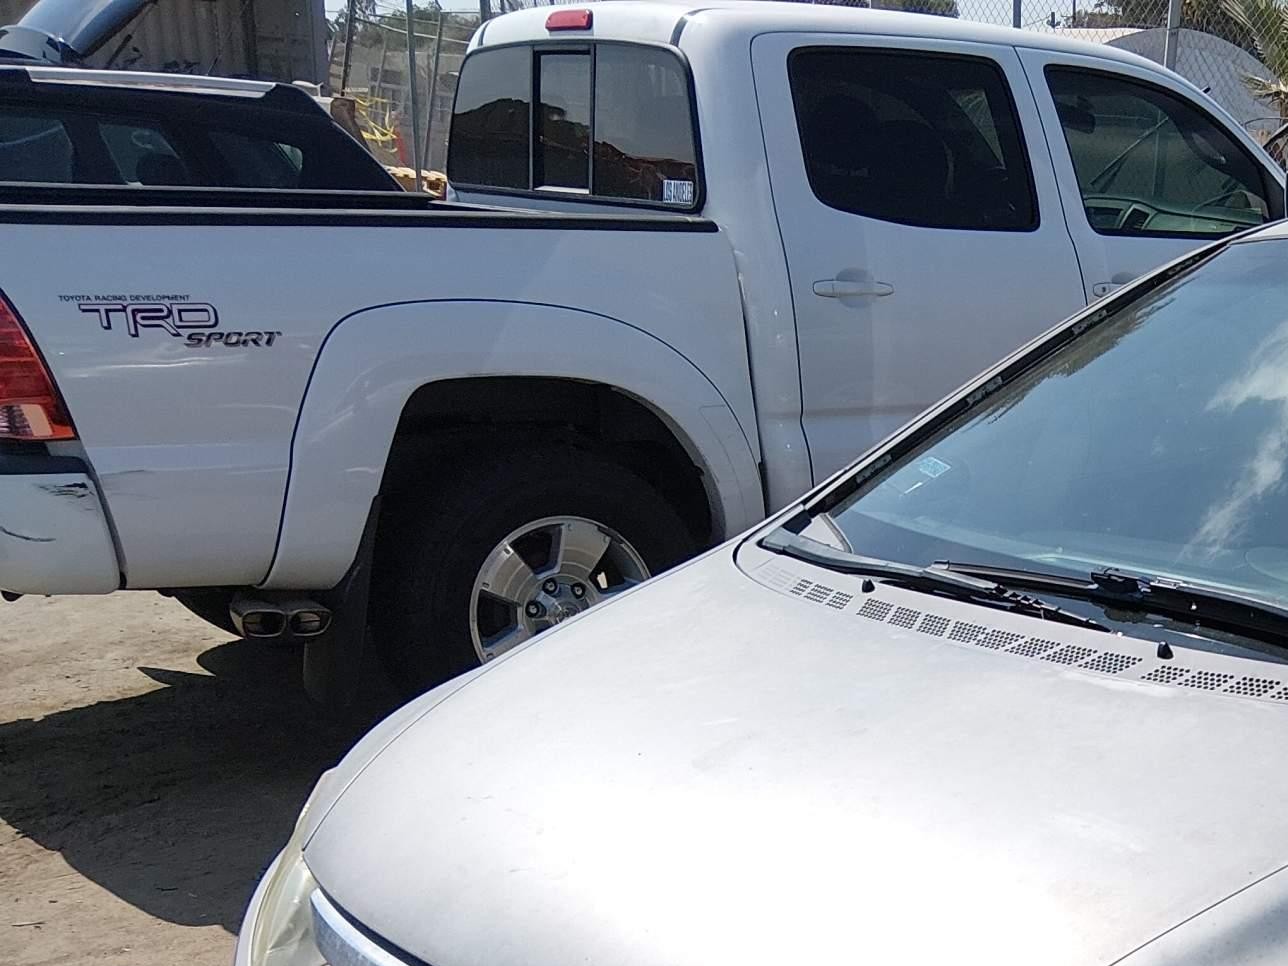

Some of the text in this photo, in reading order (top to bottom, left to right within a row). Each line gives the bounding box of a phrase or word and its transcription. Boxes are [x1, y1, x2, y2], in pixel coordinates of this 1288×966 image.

[58, 294, 190, 302] TOYOTA RACING DEVELOPMENT
[78, 303, 219, 338] TRD
[184, 331, 282, 348] SPORT
